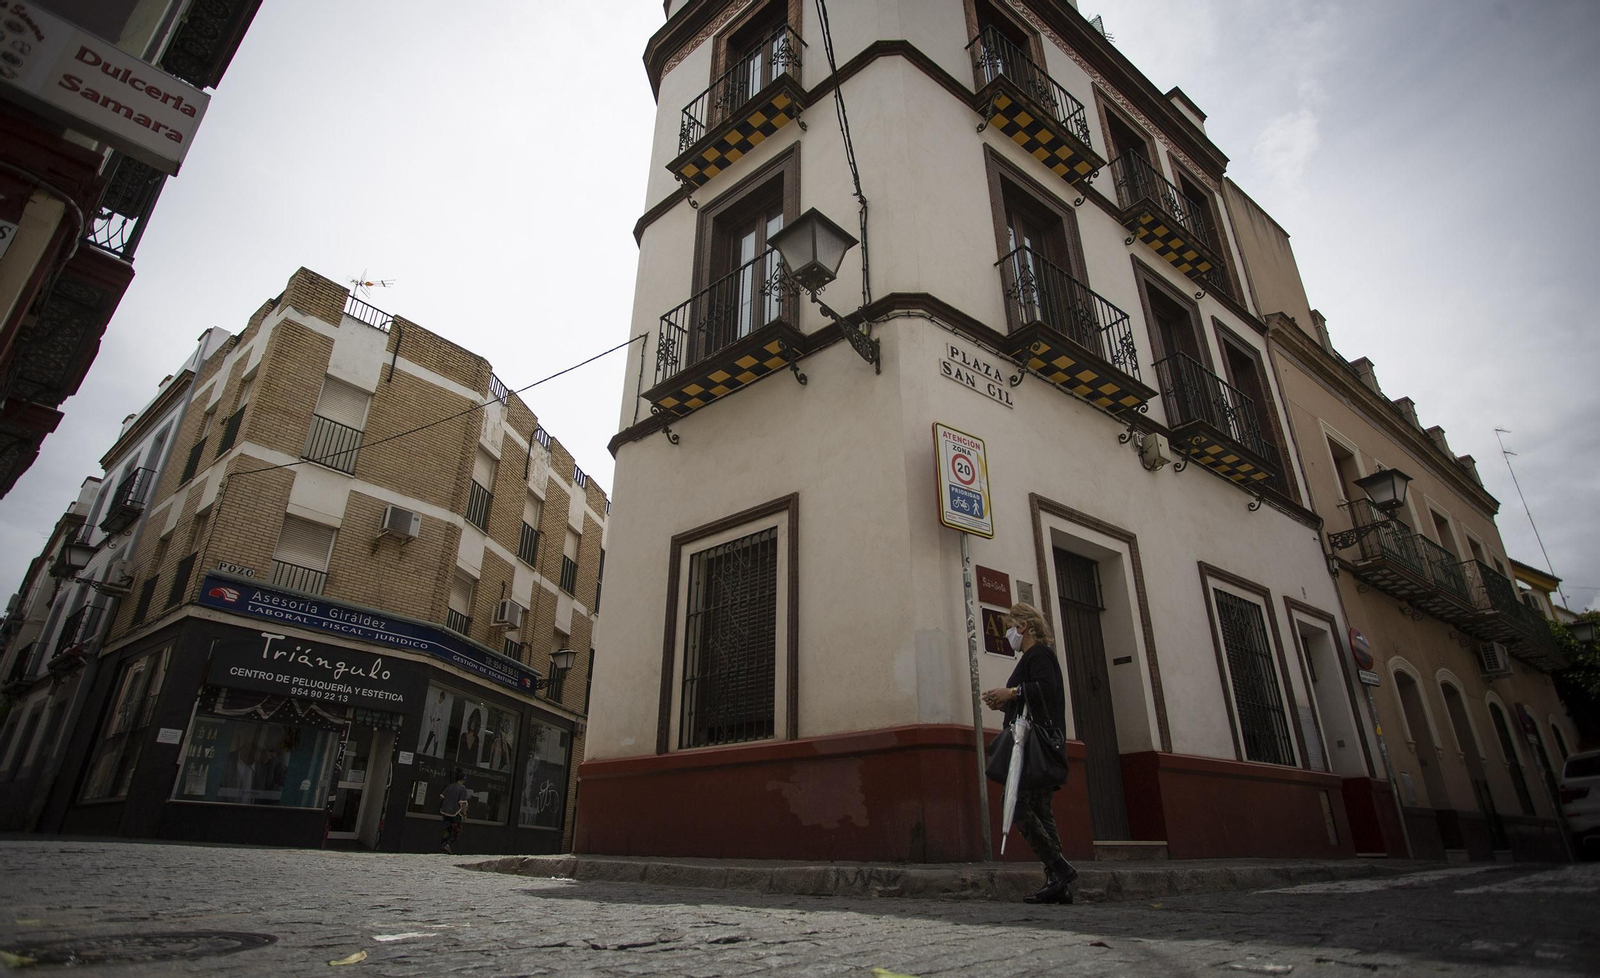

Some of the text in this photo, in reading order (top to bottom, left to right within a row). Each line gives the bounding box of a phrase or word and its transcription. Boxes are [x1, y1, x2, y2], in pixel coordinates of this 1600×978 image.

[74, 45, 197, 118] Dulceria
[58, 73, 184, 144] Samara
[950, 346, 1002, 382] PLAZA
[942, 361, 1013, 406] SAN GIL
[942, 430, 981, 450] ATENCIÓN
[952, 444, 972, 456] ZONA
[957, 462, 971, 476] 20
[951, 486, 981, 500] PRIORIDAD
[219, 562, 254, 577] POZO
[247, 605, 309, 624] LABORAL
[322, 622, 364, 636] FISCAL
[375, 632, 429, 650] JURIDICO
[252, 591, 386, 630] Asesoría Giráldez
[260, 631, 391, 680] Triángulo
[452, 655, 518, 687] GESTIÓN DE ESCRITURAS
[229, 666, 404, 702] CENTRO DE PELUQUERÍA Y ESTÉTICA
[290, 687, 349, 703] 954 90 22 13
